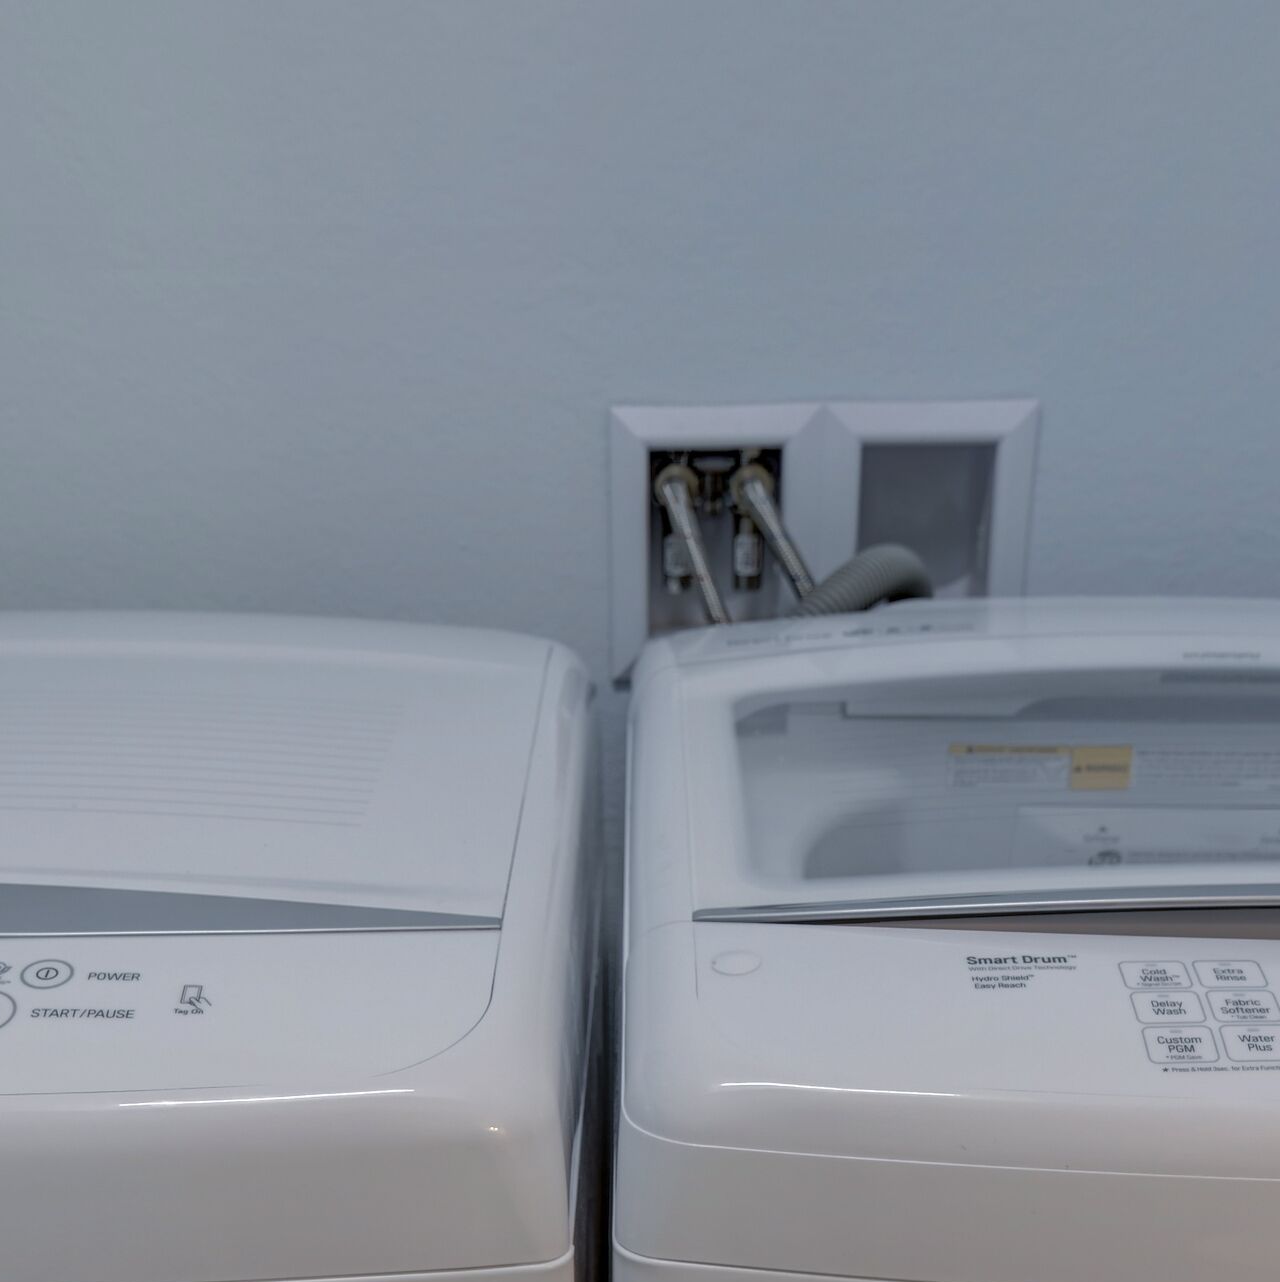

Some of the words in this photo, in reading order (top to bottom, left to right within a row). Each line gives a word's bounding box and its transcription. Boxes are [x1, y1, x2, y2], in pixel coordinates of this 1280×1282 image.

[966, 956, 1018, 965] Smart
[87, 972, 141, 981] POWER
[1150, 1000, 1183, 1008] Delay
[30, 1008, 136, 1019] START/PAUSE
[1152, 1007, 1187, 1015] Wash
[1220, 1006, 1271, 1015] Softener
[1157, 1036, 1202, 1044] Custom
[1238, 1035, 1276, 1043] Water
[1168, 1044, 1196, 1053] PGM
[1247, 1043, 1273, 1052] Plus
